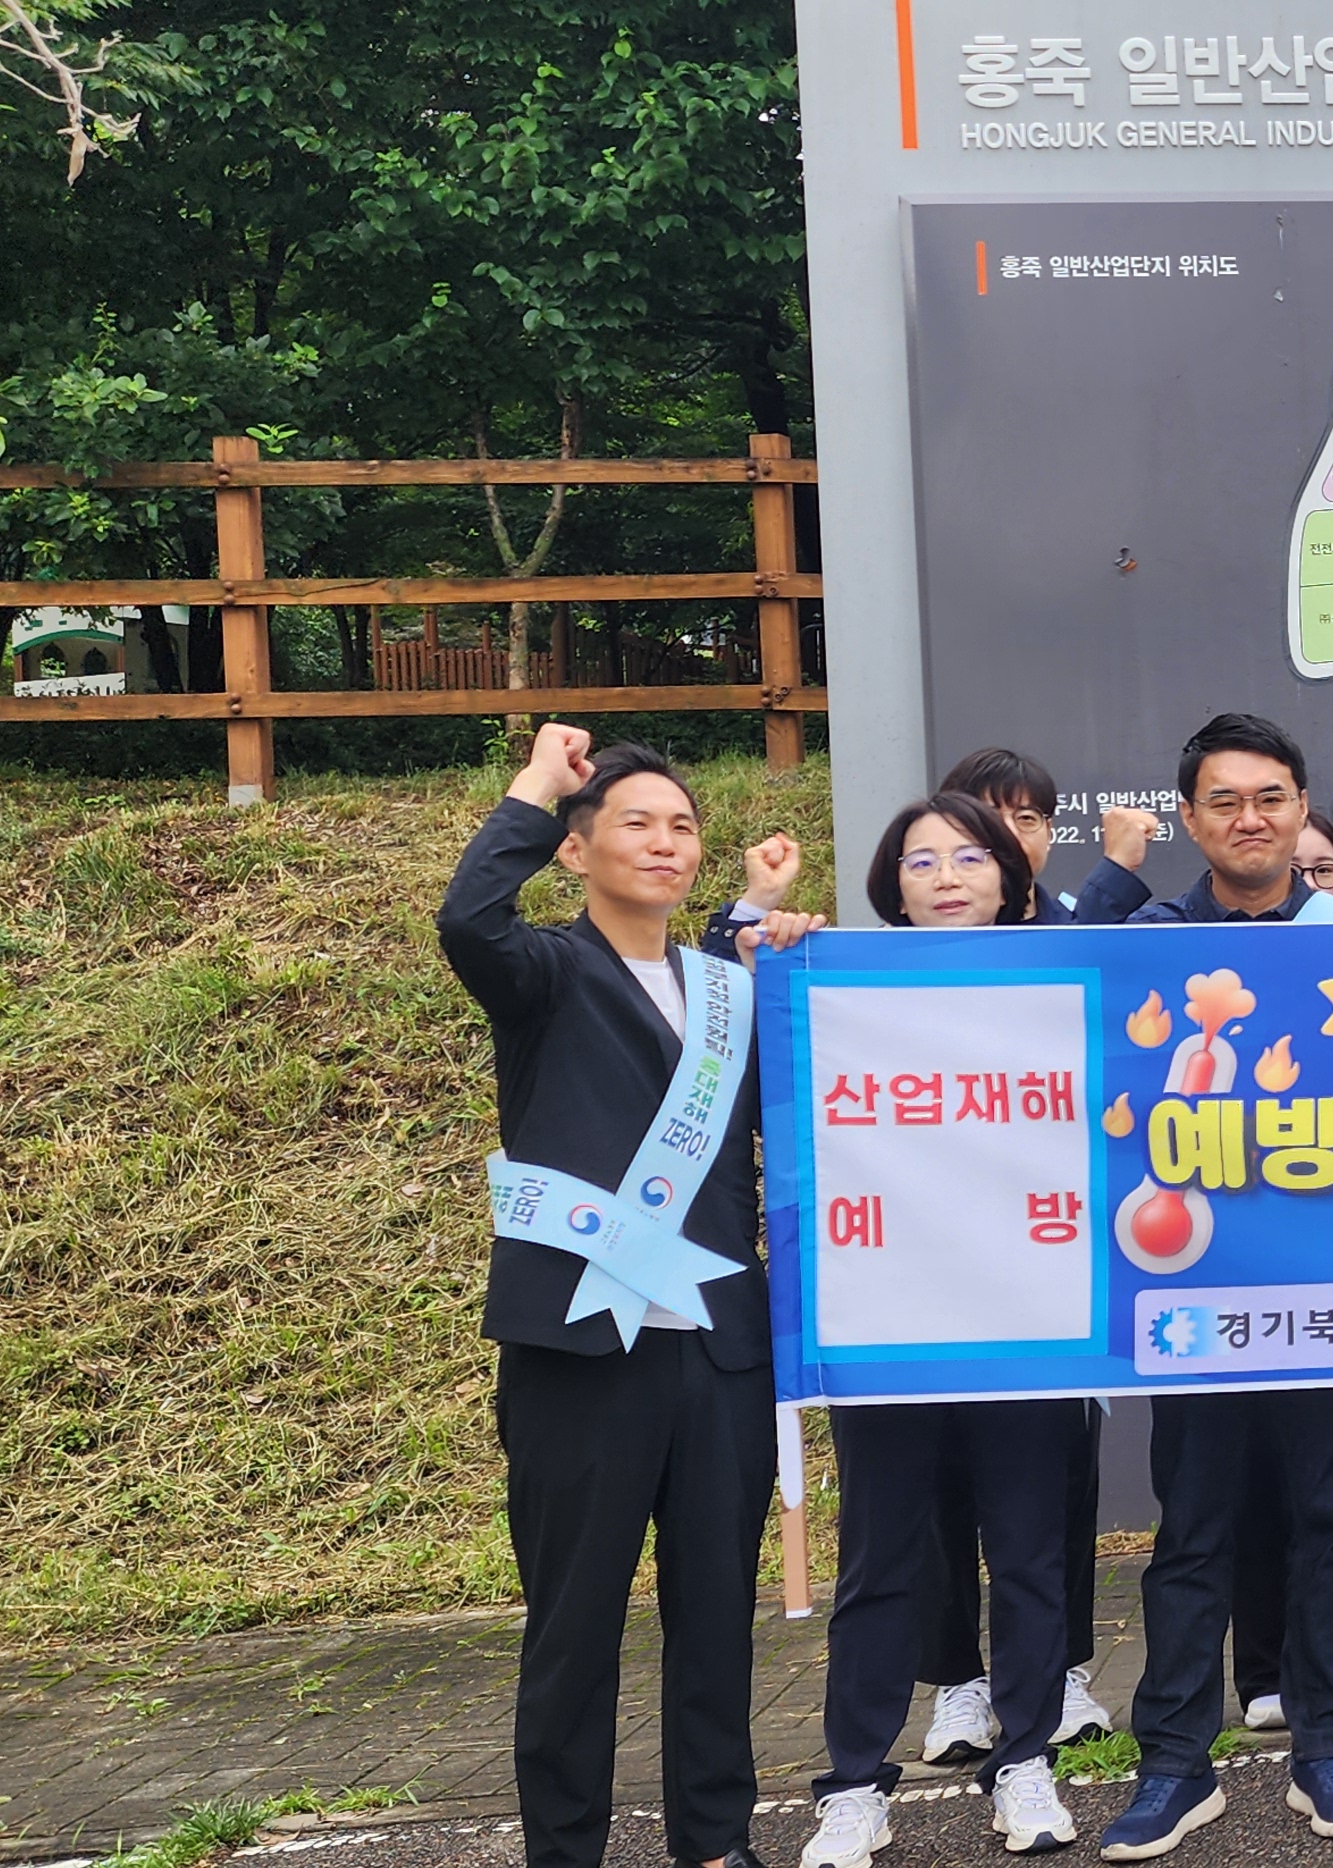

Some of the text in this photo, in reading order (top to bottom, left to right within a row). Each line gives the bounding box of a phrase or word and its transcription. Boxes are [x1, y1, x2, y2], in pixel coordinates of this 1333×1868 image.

[959, 36, 1091, 108] 홍죽
[961, 122, 1106, 149] HONGJUK
[1116, 120, 1257, 148] GENERAL
[1000, 253, 1240, 279] 홍죽 일반산업단지 위치도
[1096, 789, 1181, 814] 일반산업
[824, 1069, 1076, 1127] 산업재해
[659, 1118, 710, 1162] ZERO!
[508, 1177, 549, 1227] ZERO!
